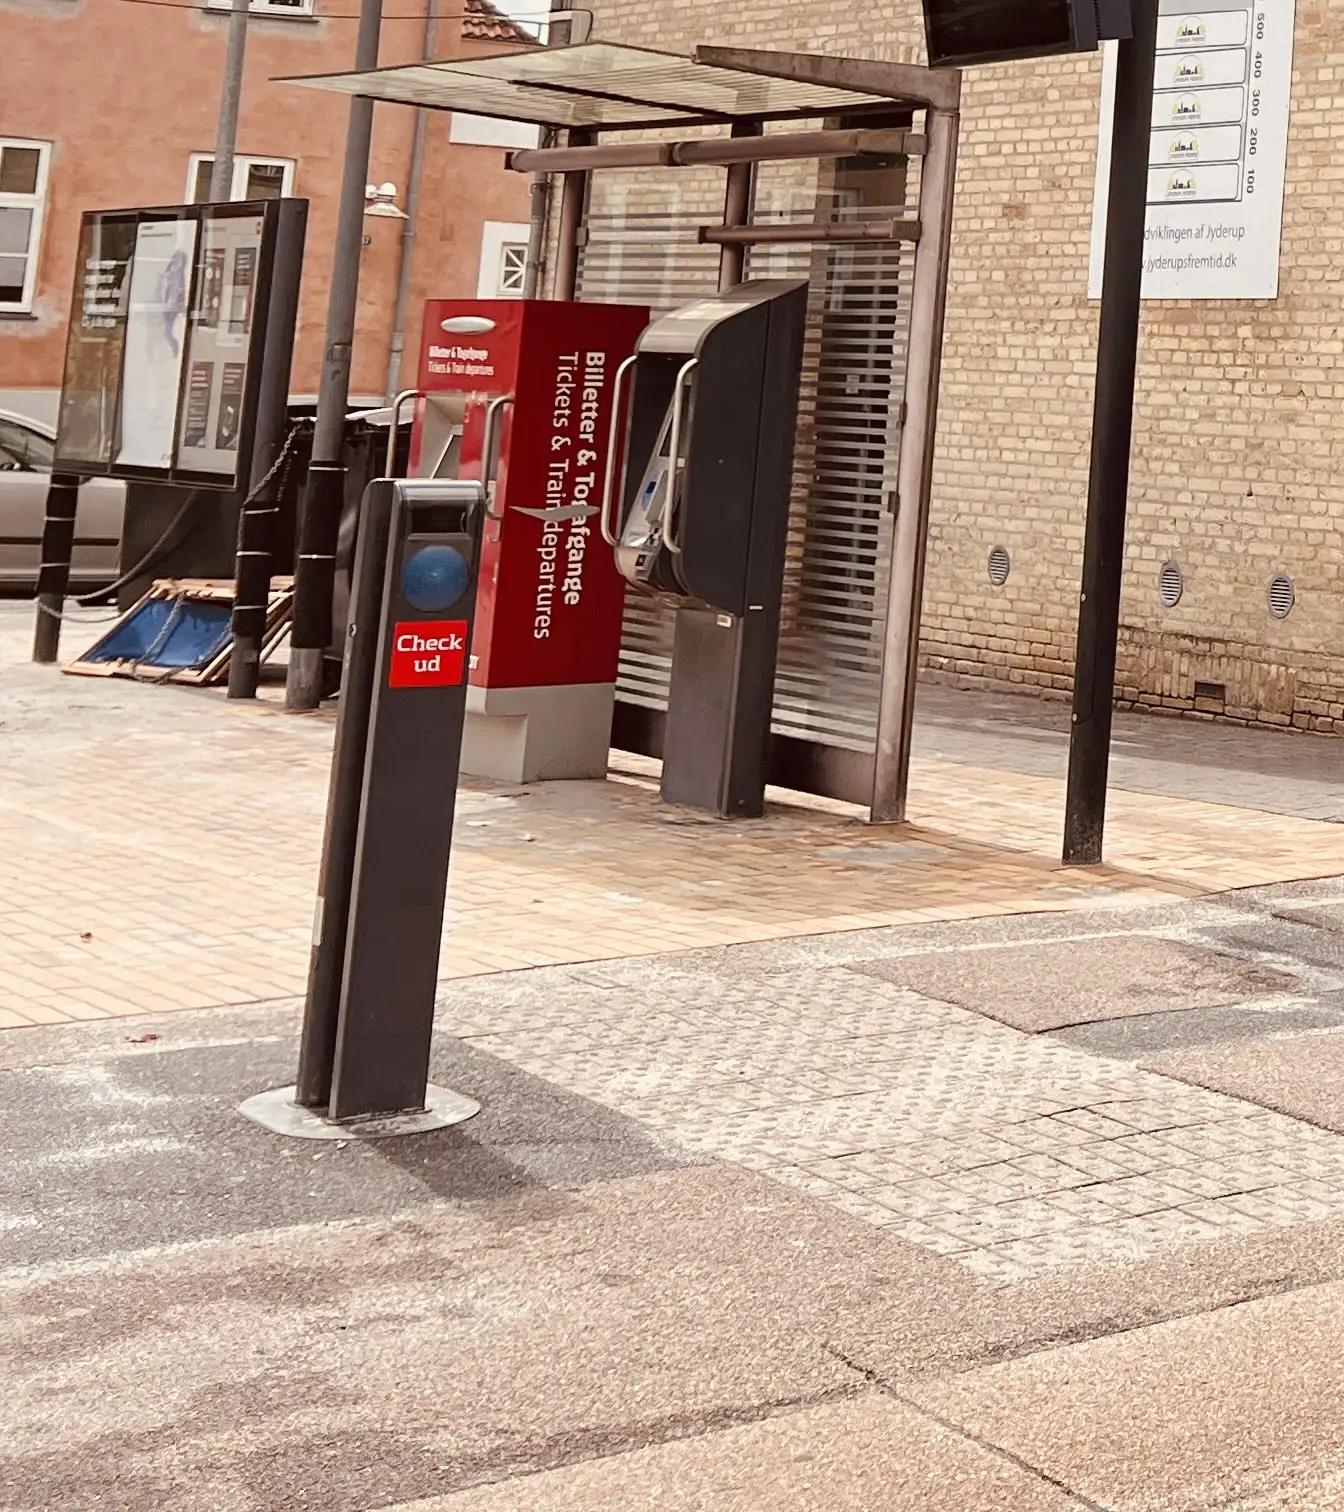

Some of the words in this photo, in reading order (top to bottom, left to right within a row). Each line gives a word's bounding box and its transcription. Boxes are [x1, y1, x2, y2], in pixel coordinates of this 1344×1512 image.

[1256, 13, 1266, 40] 500
[1253, 51, 1263, 79] 400
[1251, 89, 1261, 117] 300
[1248, 128, 1258, 156] 200
[1246, 169, 1256, 194] 100
[1194, 224, 1206, 239] af
[1205, 223, 1245, 242] Jyderup
[552, 351, 579, 428] Tickets
[579, 351, 606, 443] Billetter
[550, 435, 572, 452] &
[576, 448, 597, 467] &
[545, 458, 570, 514] Train
[533, 519, 564, 640] departures
[396, 633, 463, 653] Check
[413, 654, 441, 673] ud
